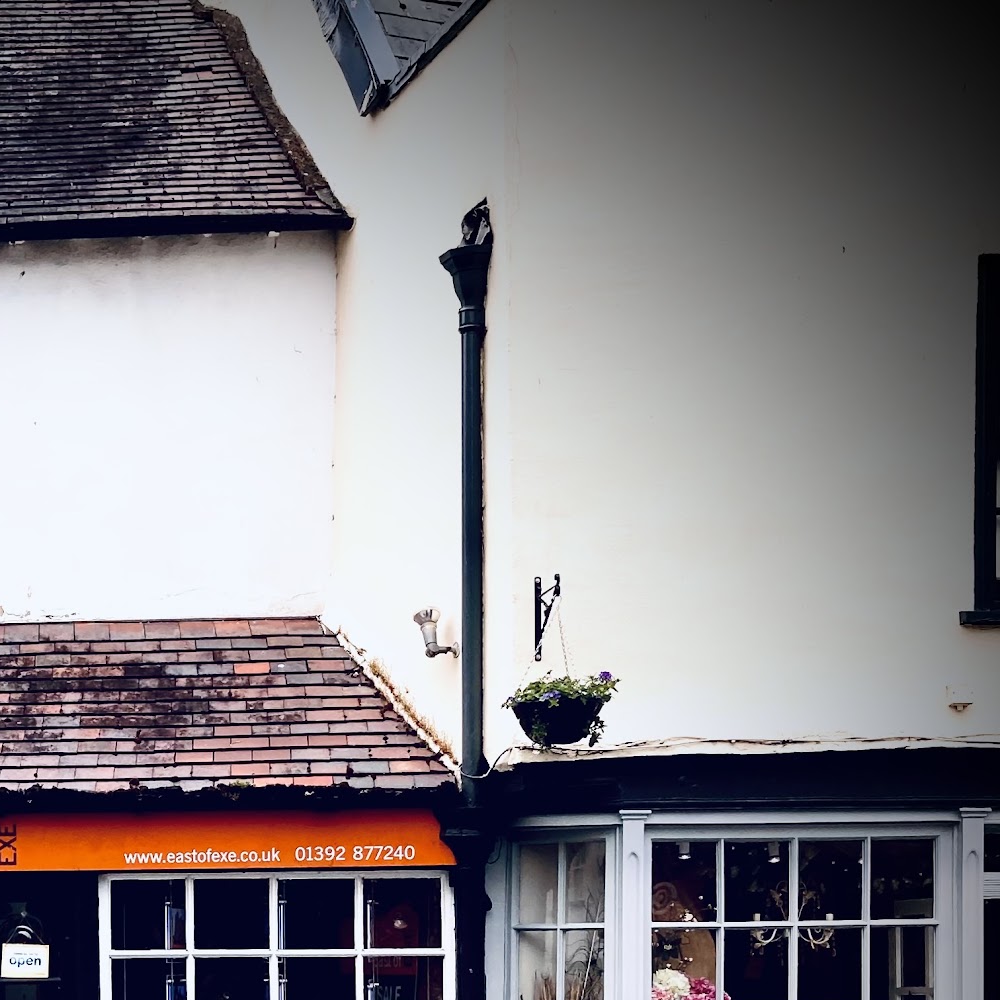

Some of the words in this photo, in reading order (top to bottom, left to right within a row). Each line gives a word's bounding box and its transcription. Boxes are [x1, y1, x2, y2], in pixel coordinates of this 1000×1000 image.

[124, 848, 280, 864] www.eastofexe.co.uk
[295, 846, 346, 861] 01392
[353, 845, 415, 861] 877240
[9, 957, 42, 968] open
